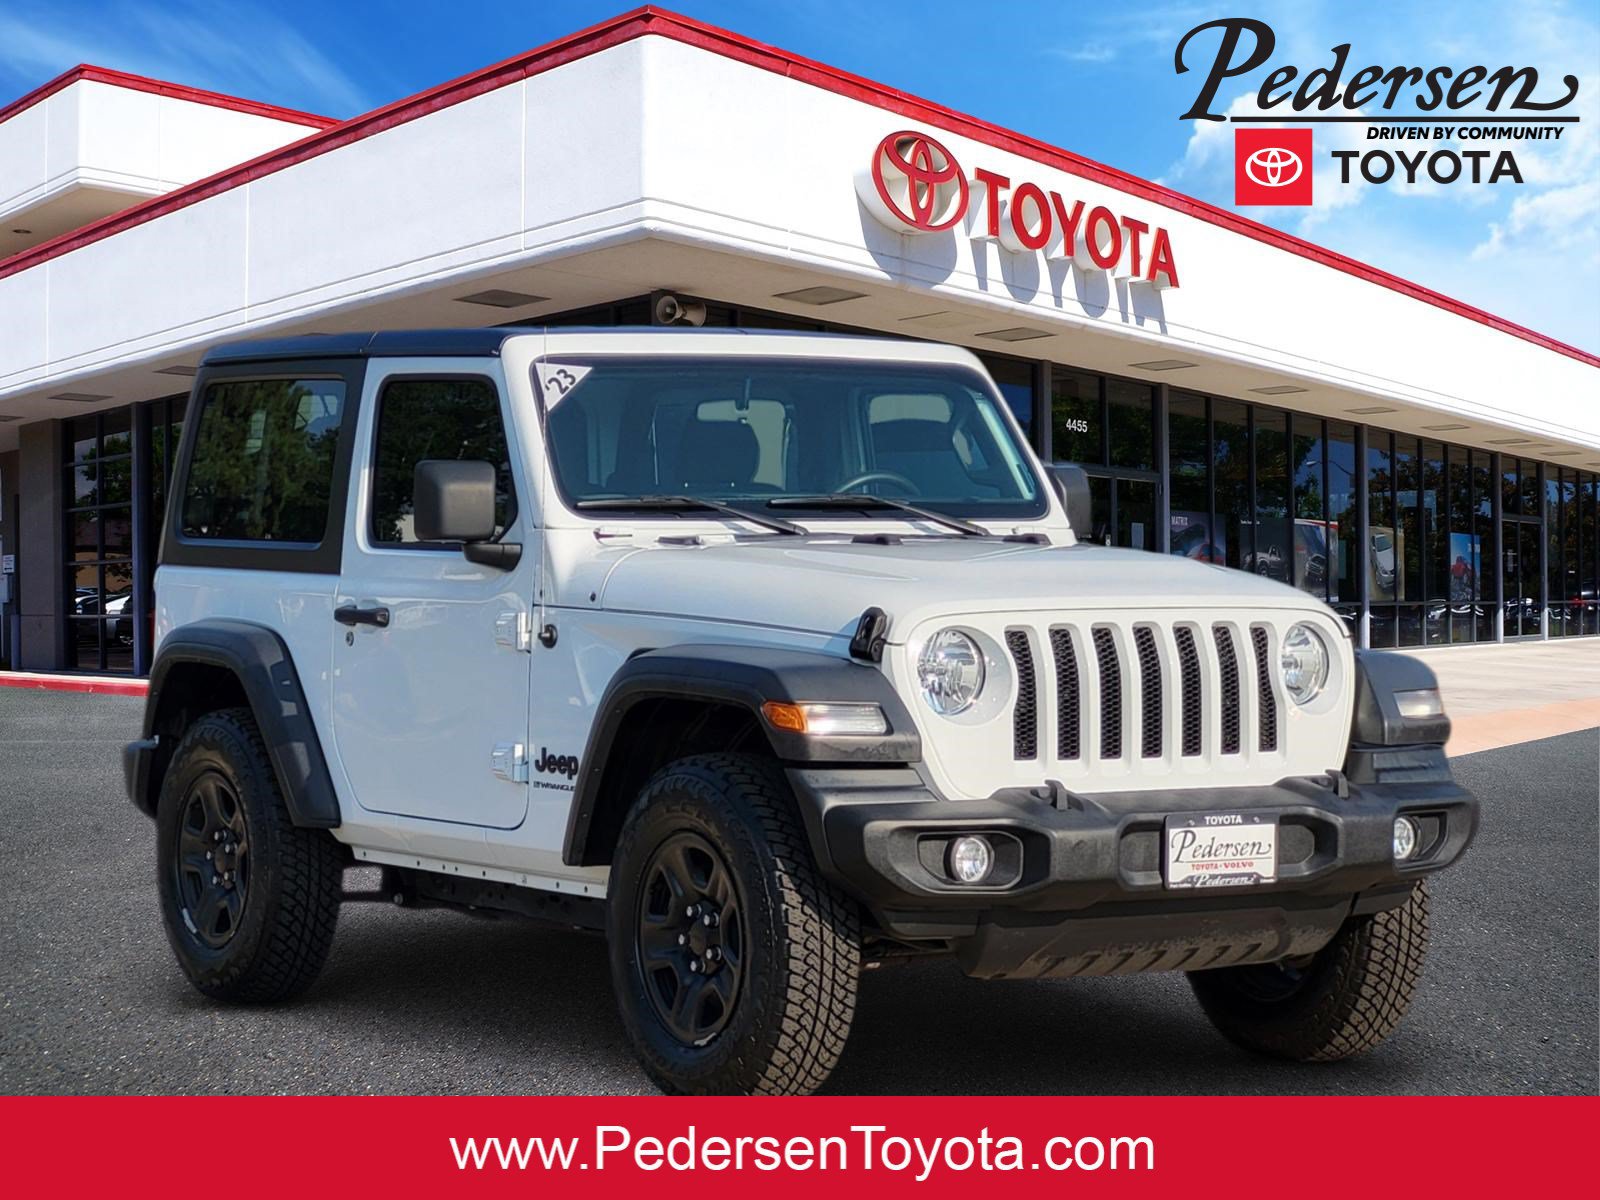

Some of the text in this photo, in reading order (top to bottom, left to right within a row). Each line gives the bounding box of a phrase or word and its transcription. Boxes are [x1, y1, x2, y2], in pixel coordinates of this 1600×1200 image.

[974, 167, 1180, 289] TOYOTA
[1065, 418, 1088, 433] 4455
[535, 746, 579, 780] Jeep
[541, 782, 576, 791] WRANGLE
[1204, 815, 1242, 825] TOYOTA
[1171, 830, 1271, 863] Pedersen
